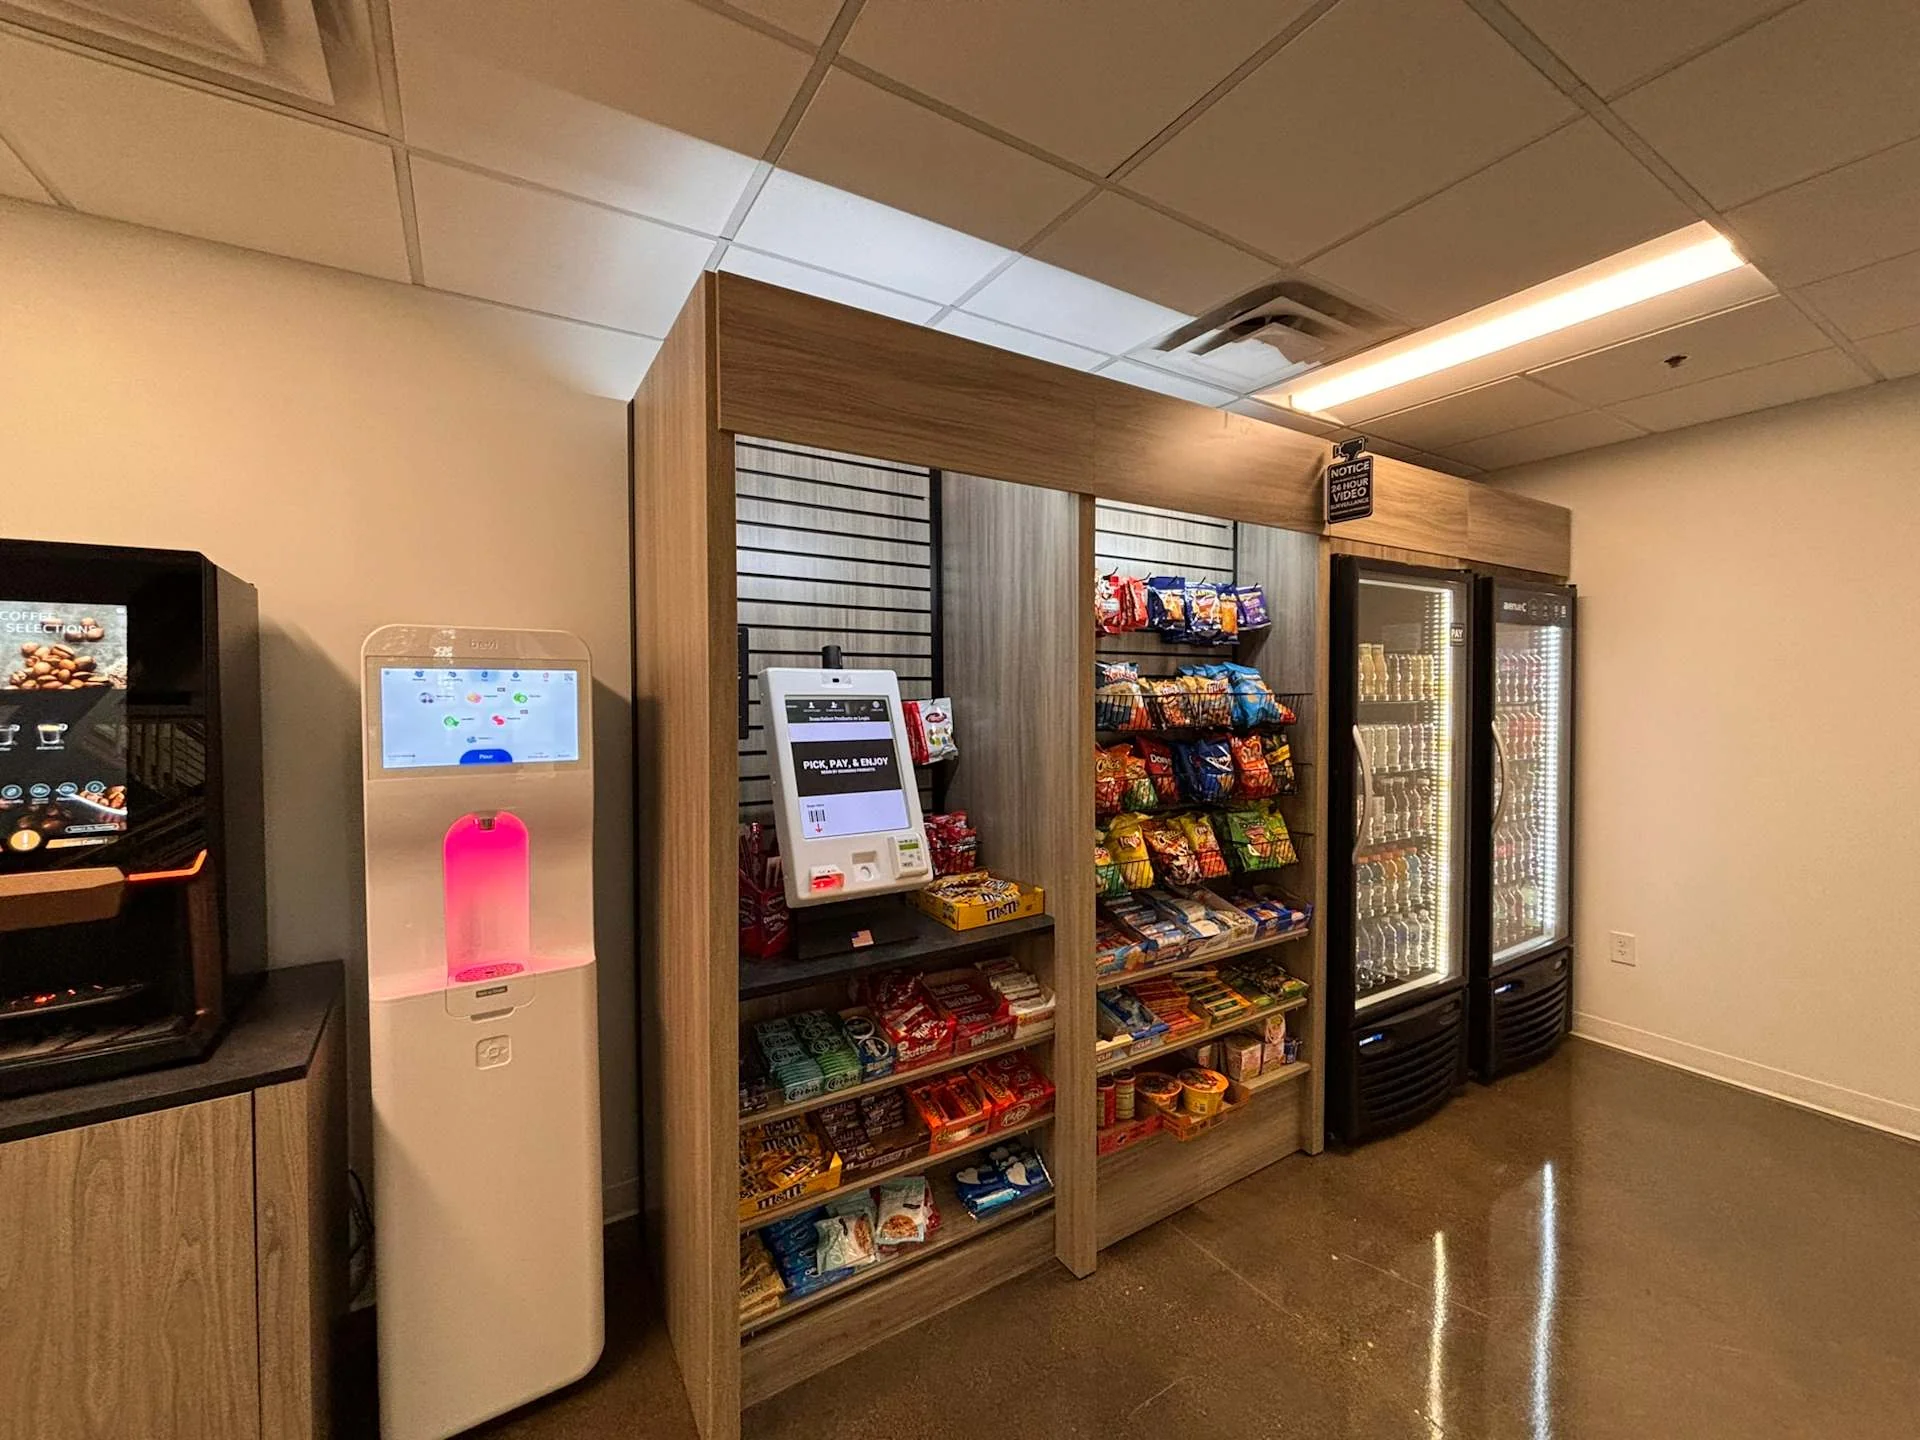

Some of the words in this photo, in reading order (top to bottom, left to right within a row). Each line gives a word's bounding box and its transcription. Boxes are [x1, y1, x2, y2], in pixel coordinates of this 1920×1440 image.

[1331, 461, 1370, 478] NOTICE
[1331, 484, 1341, 493] 24
[1343, 478, 1368, 490] HOUR
[1333, 487, 1366, 502] VIDEO
[0, 611, 56, 620] COFFEE
[6, 623, 97, 633] SELECTIONS
[803, 760, 828, 769] PICK,
[829, 759, 851, 768] PAY,
[853, 758, 859, 767] &
[860, 757, 888, 766] ENJOY
